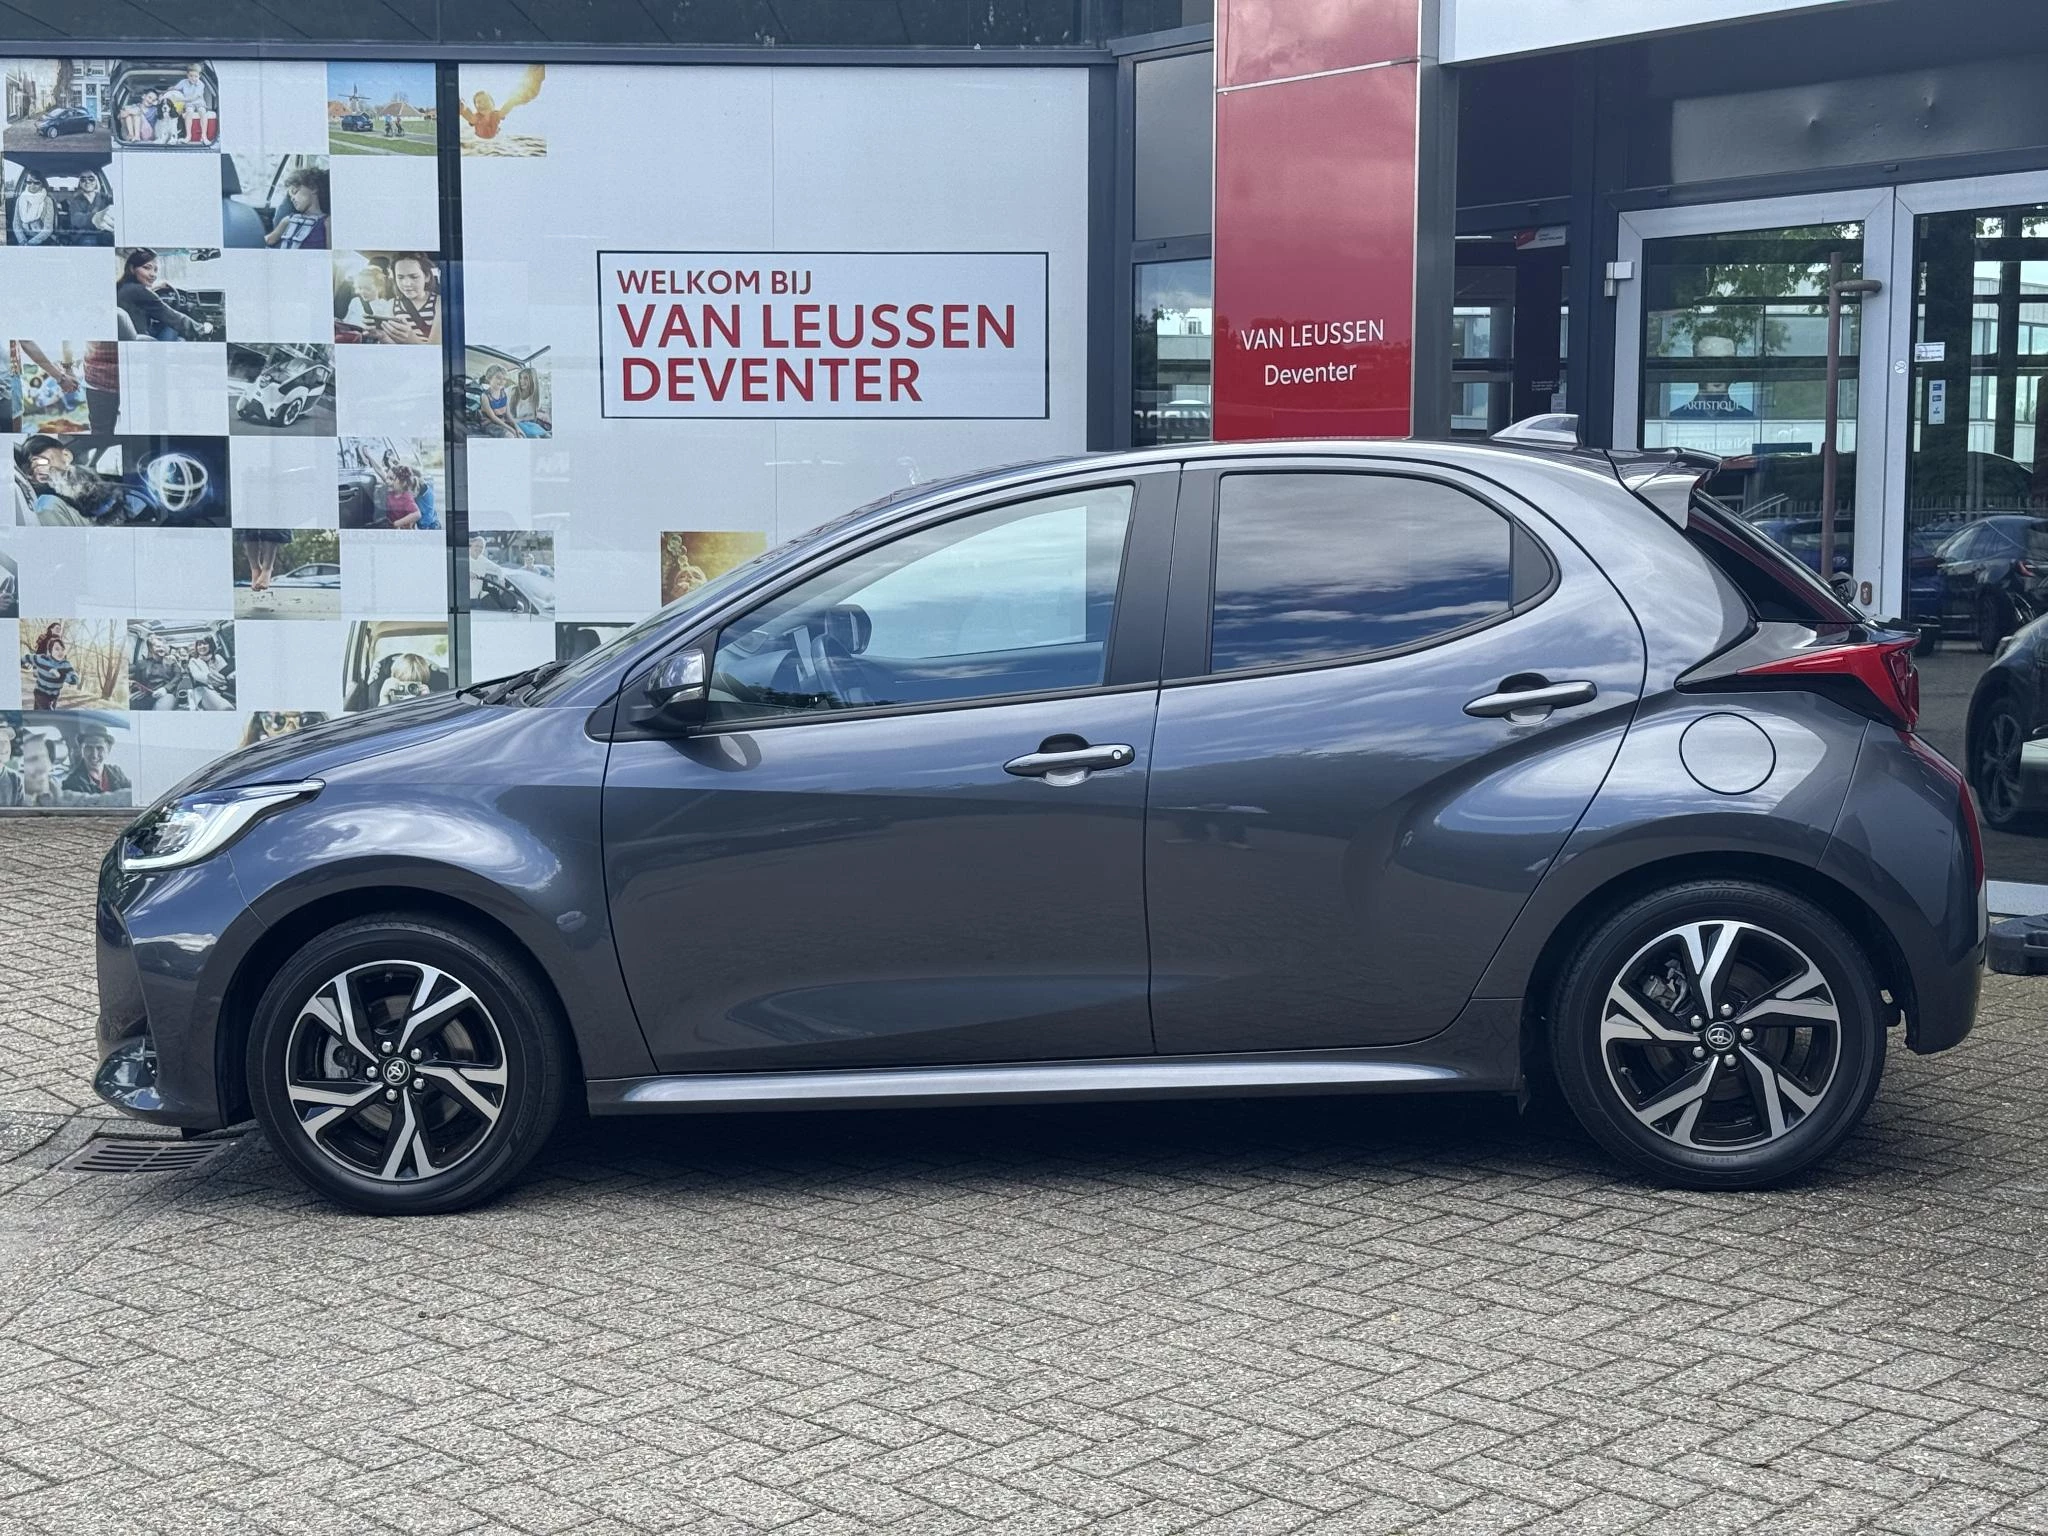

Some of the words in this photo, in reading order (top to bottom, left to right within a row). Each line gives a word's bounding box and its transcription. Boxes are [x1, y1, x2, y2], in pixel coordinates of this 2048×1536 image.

[616, 270, 761, 294] WELKOM
[771, 270, 812, 295] BIJ
[617, 304, 741, 349] VAN
[762, 303, 1015, 349] LEUSSEN
[1241, 327, 1284, 351] VAN
[1290, 318, 1384, 348] LEUSSEN
[622, 357, 923, 402] DEVENTER
[1264, 361, 1358, 386] Deventer
